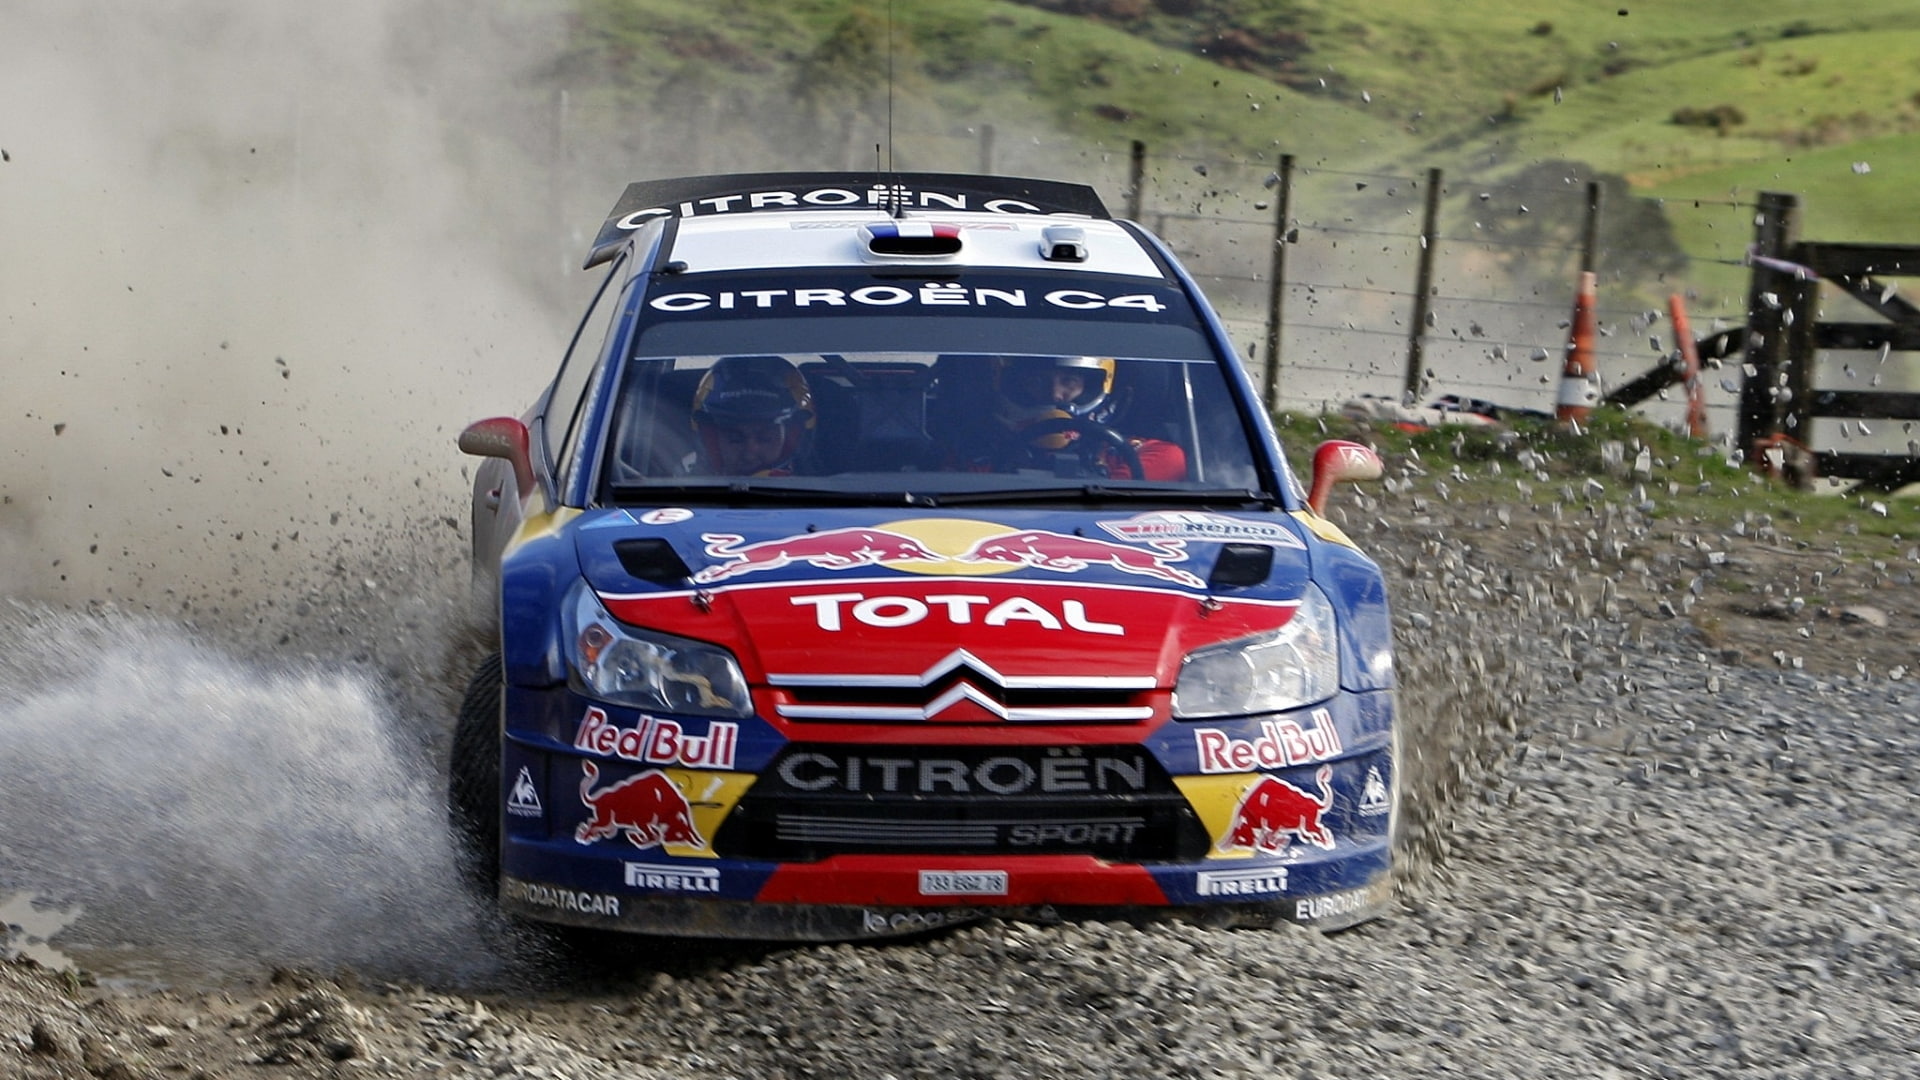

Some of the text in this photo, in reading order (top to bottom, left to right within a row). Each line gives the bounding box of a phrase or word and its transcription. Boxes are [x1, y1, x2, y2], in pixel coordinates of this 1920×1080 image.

[650, 282, 1167, 313] CITROËN C4
[789, 592, 1125, 636] TOTAL
[575, 706, 738, 770] Red Bull
[1194, 707, 1343, 774] Red Bull
[777, 747, 1145, 795] CITROËN
[1007, 823, 1145, 845] SPORT
[624, 861, 720, 892] PIRELLI
[1197, 866, 1289, 897] PIRELLI
[505, 877, 620, 917] ERODATACAR
